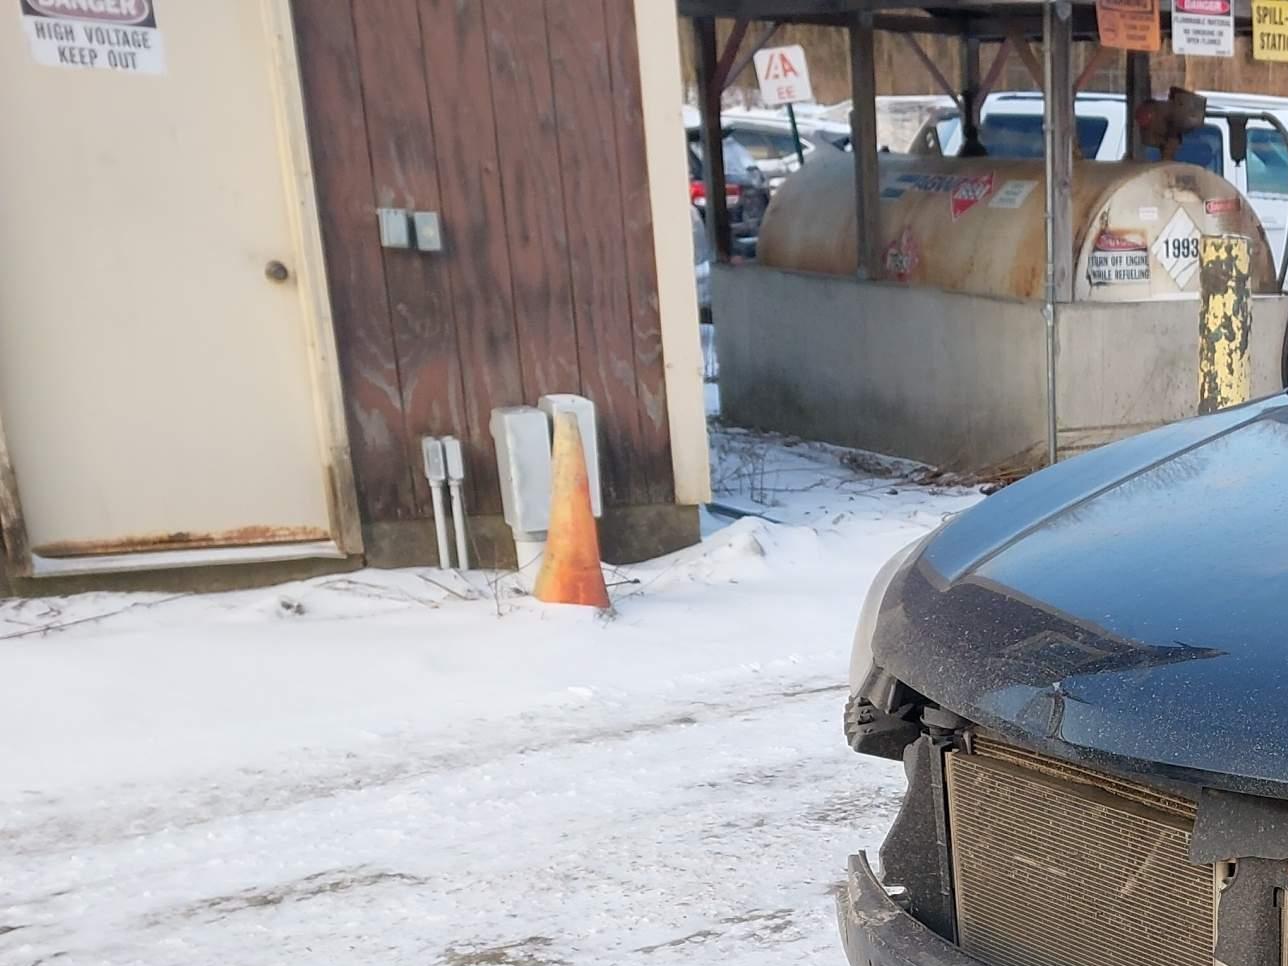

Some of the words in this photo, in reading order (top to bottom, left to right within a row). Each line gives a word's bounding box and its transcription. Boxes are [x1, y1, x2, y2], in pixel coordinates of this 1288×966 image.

[34, 21, 75, 43] HIGH
[84, 26, 151, 49] VOLTAGE
[57, 46, 98, 68] KEEP
[107, 50, 137, 70] OUT
[1163, 238, 1199, 259] 1993
[1111, 256, 1123, 267] OFF
